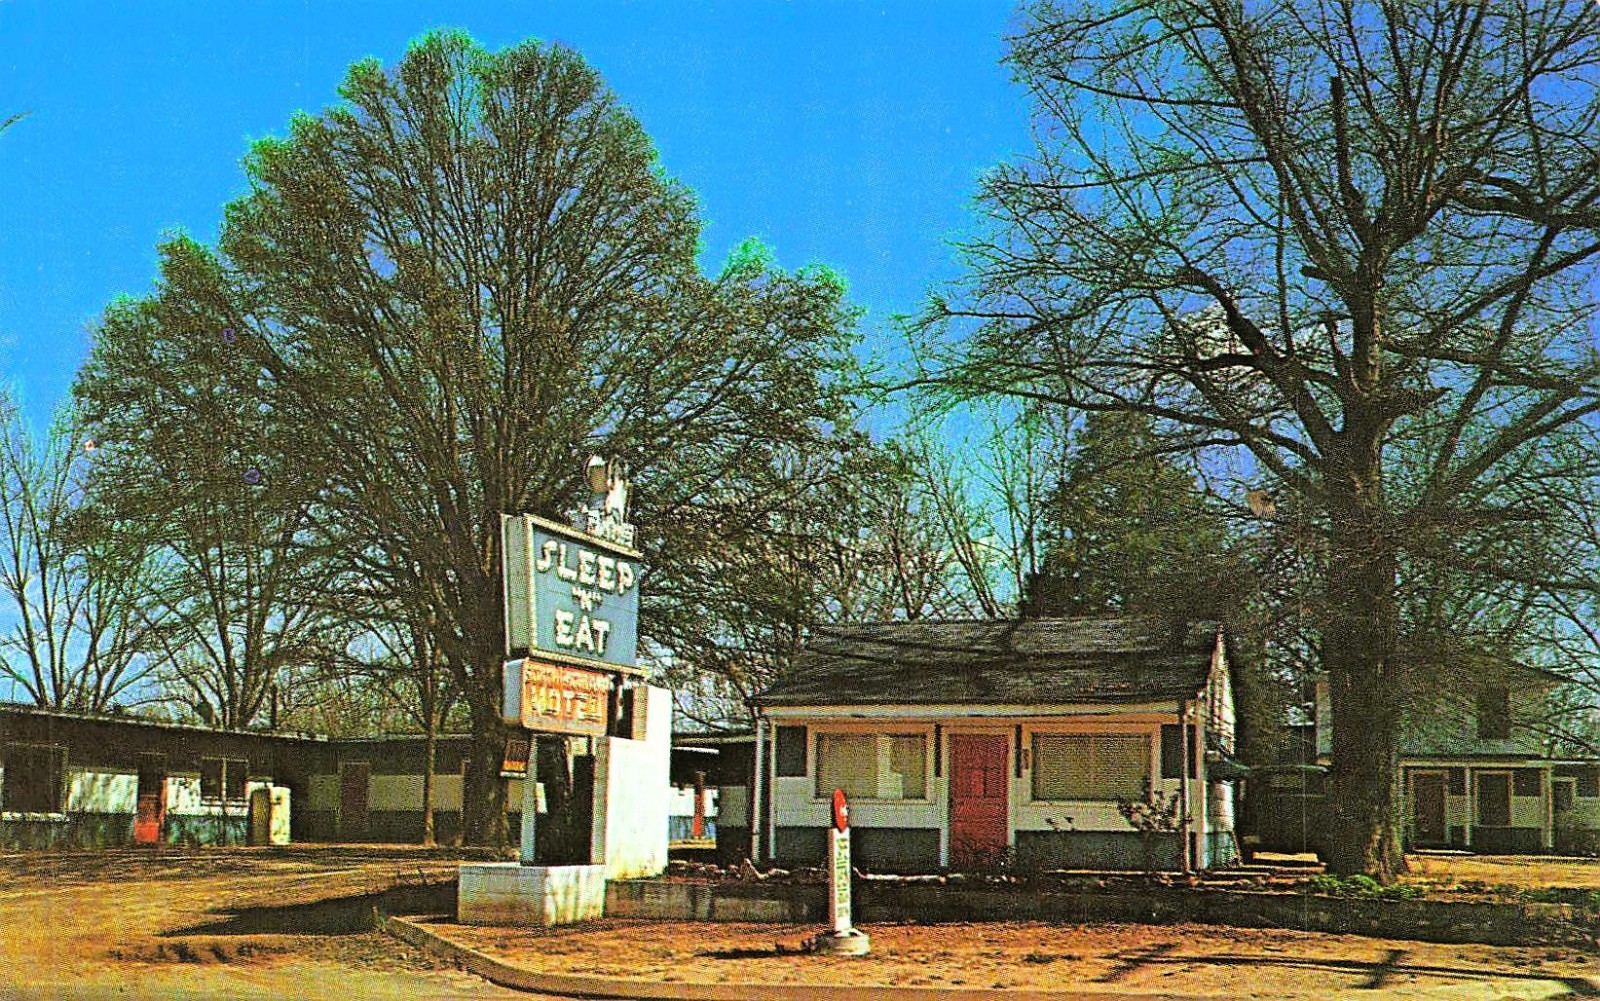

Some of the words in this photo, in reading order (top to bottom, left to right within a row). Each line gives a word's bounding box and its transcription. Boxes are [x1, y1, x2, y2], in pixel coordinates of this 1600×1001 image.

[536, 540, 635, 595] SLEEP
[555, 609, 610, 656] EAT
[531, 685, 603, 722] MOTEL
